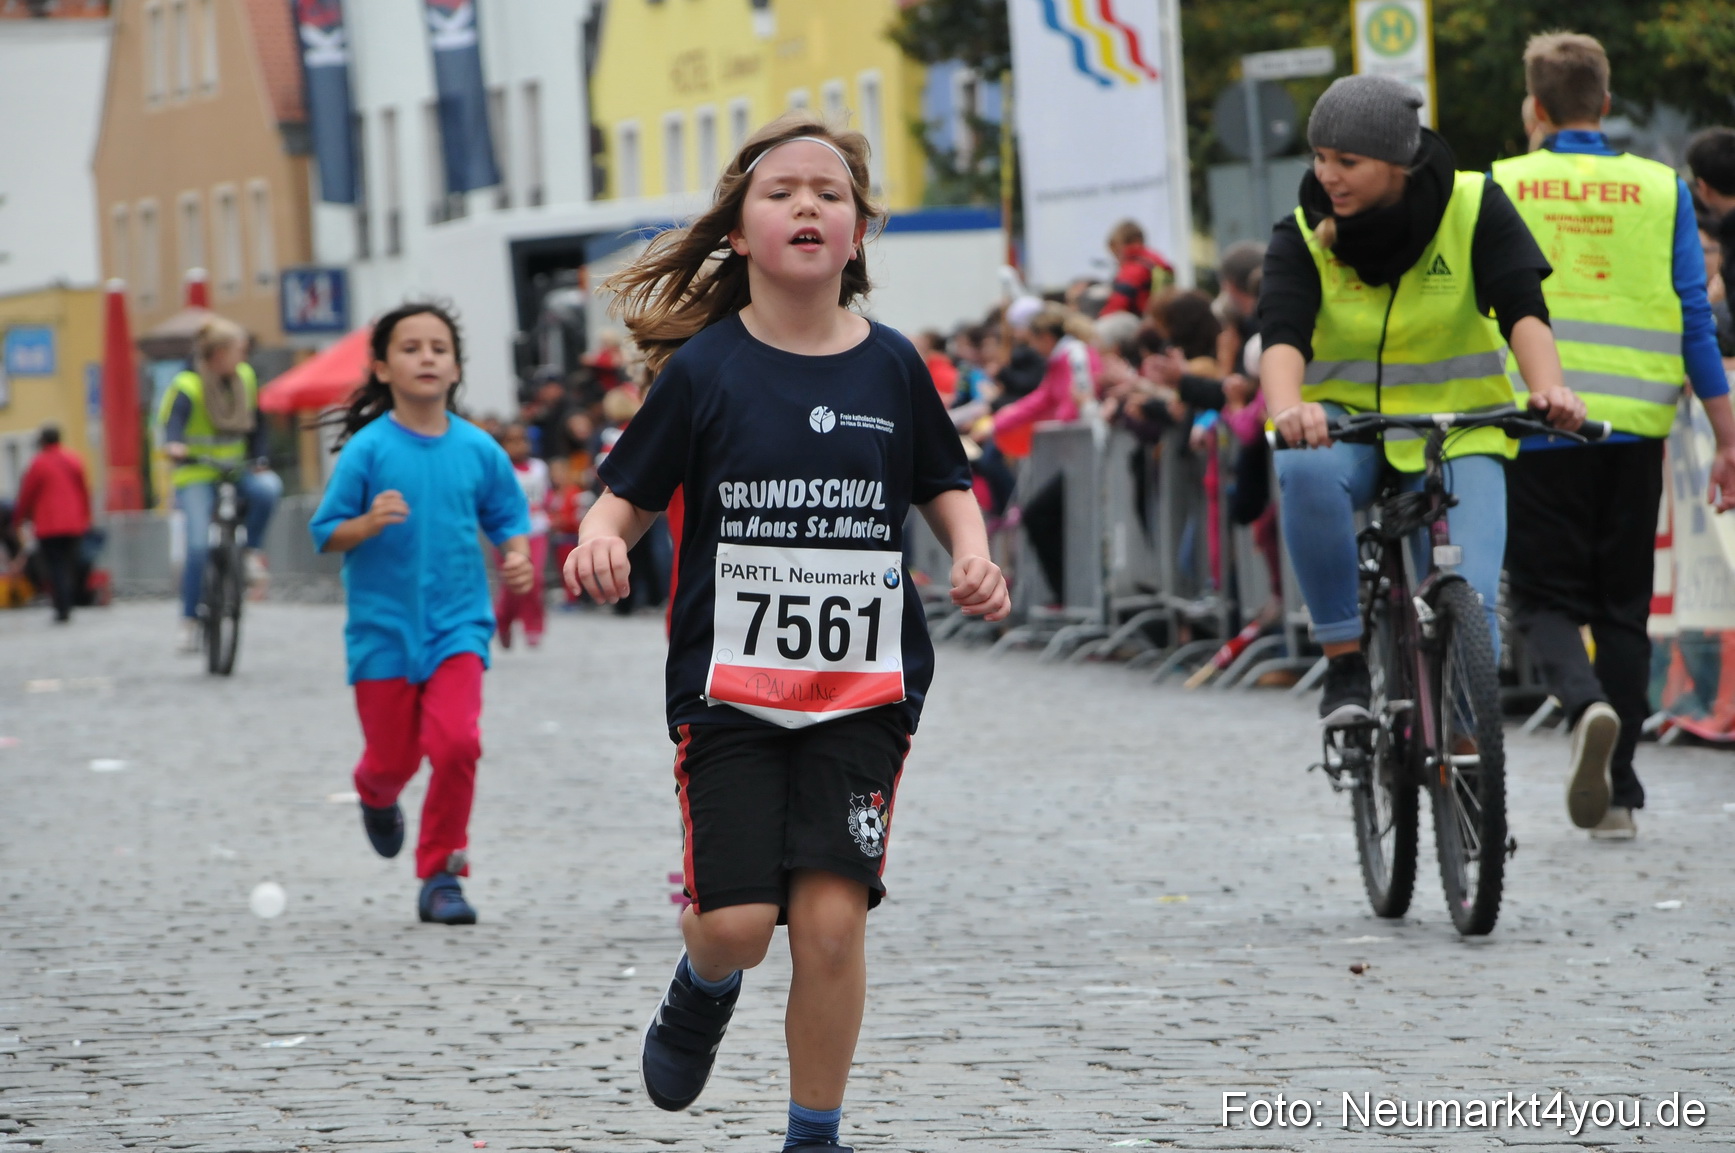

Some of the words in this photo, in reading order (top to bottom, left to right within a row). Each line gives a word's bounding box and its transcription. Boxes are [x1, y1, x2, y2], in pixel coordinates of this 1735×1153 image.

[1517, 179, 1642, 205] HELFER
[718, 478, 886, 510] GRUNDSCHUL
[720, 515, 743, 538] im
[746, 515, 798, 538] Haus
[720, 562, 784, 583] PARTL
[789, 567, 877, 587] Neumarkt
[736, 591, 883, 663] 7561
[745, 672, 841, 703] PAULINE
